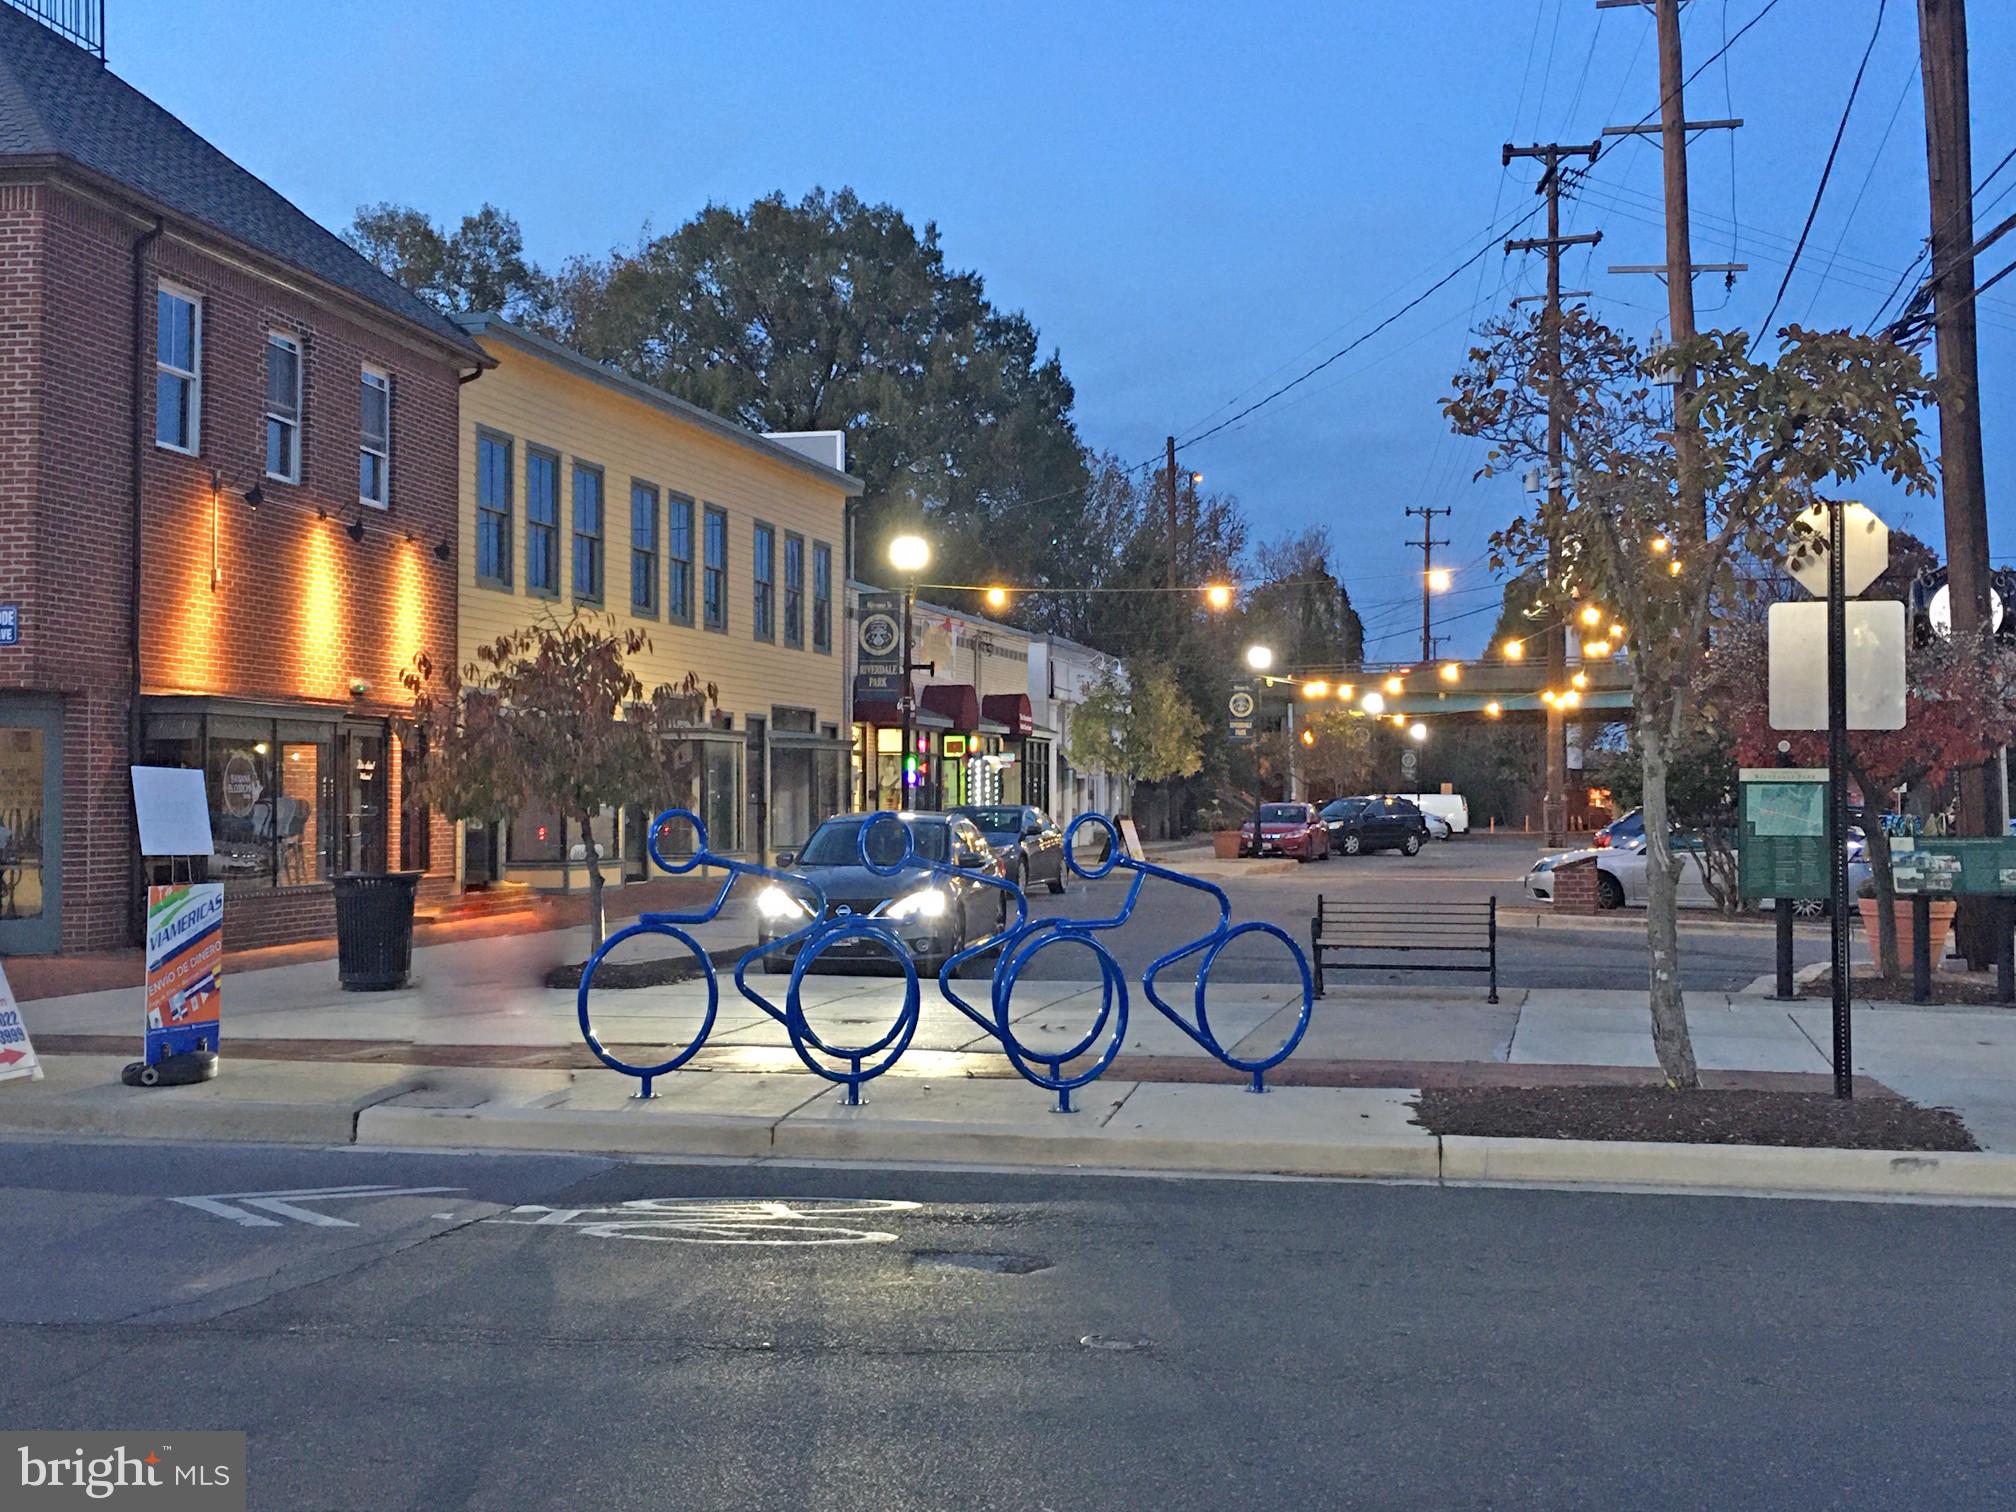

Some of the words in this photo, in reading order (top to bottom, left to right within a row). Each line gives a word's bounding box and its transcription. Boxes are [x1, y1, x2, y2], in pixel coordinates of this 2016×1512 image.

[0, 610, 14, 626] DE
[150, 893, 223, 952] VIAMERICAS
[176, 961, 190, 977] DE
[190, 940, 222, 968] DINERO
